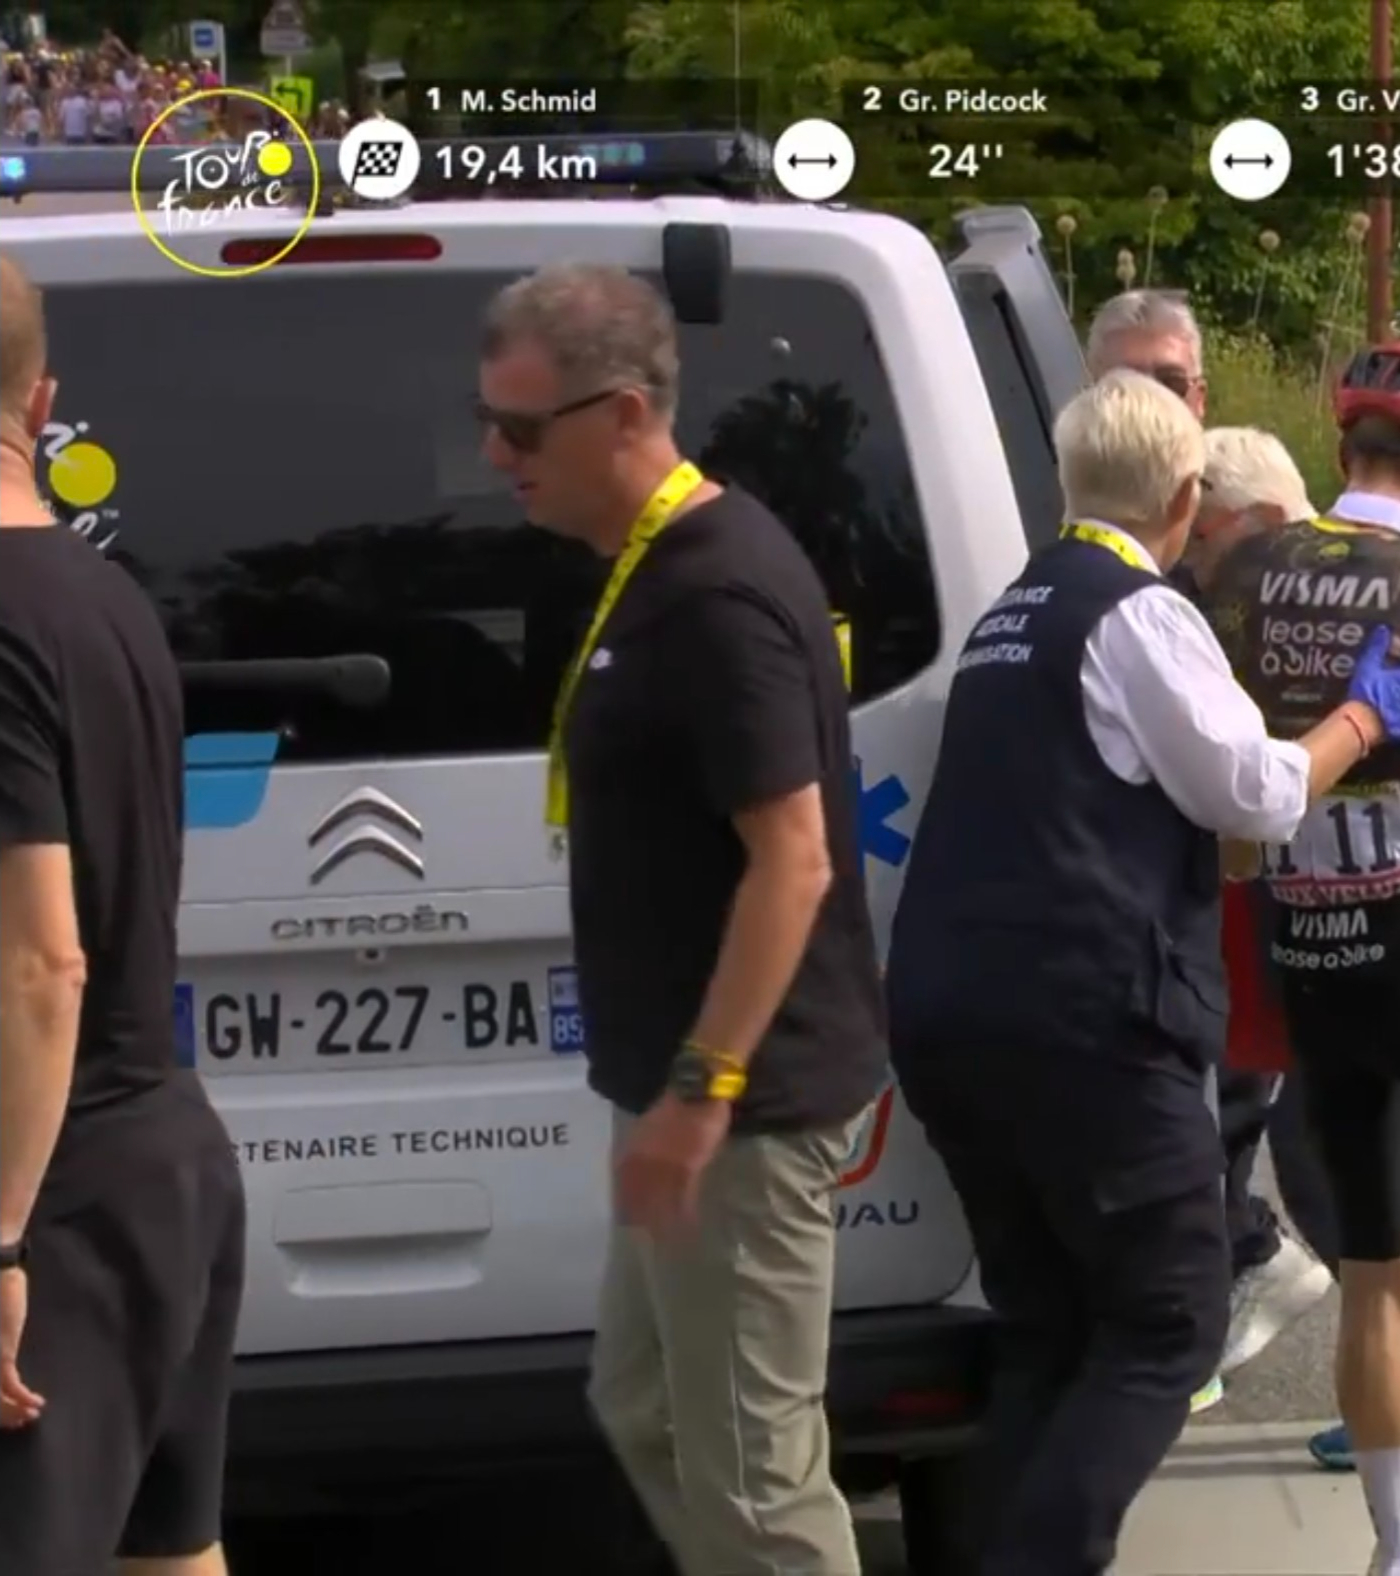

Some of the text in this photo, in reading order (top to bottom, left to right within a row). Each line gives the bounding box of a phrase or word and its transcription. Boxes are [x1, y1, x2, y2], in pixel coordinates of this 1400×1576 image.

[1259, 570, 1390, 609] VISMA
[1262, 615, 1364, 646] lease
[1326, 800, 1397, 875] 11
[1290, 907, 1370, 940] VISMA
[205, 980, 539, 1060] GW-227-BA
[233, 1123, 570, 1167] TENAIRE TECHNIQUE
